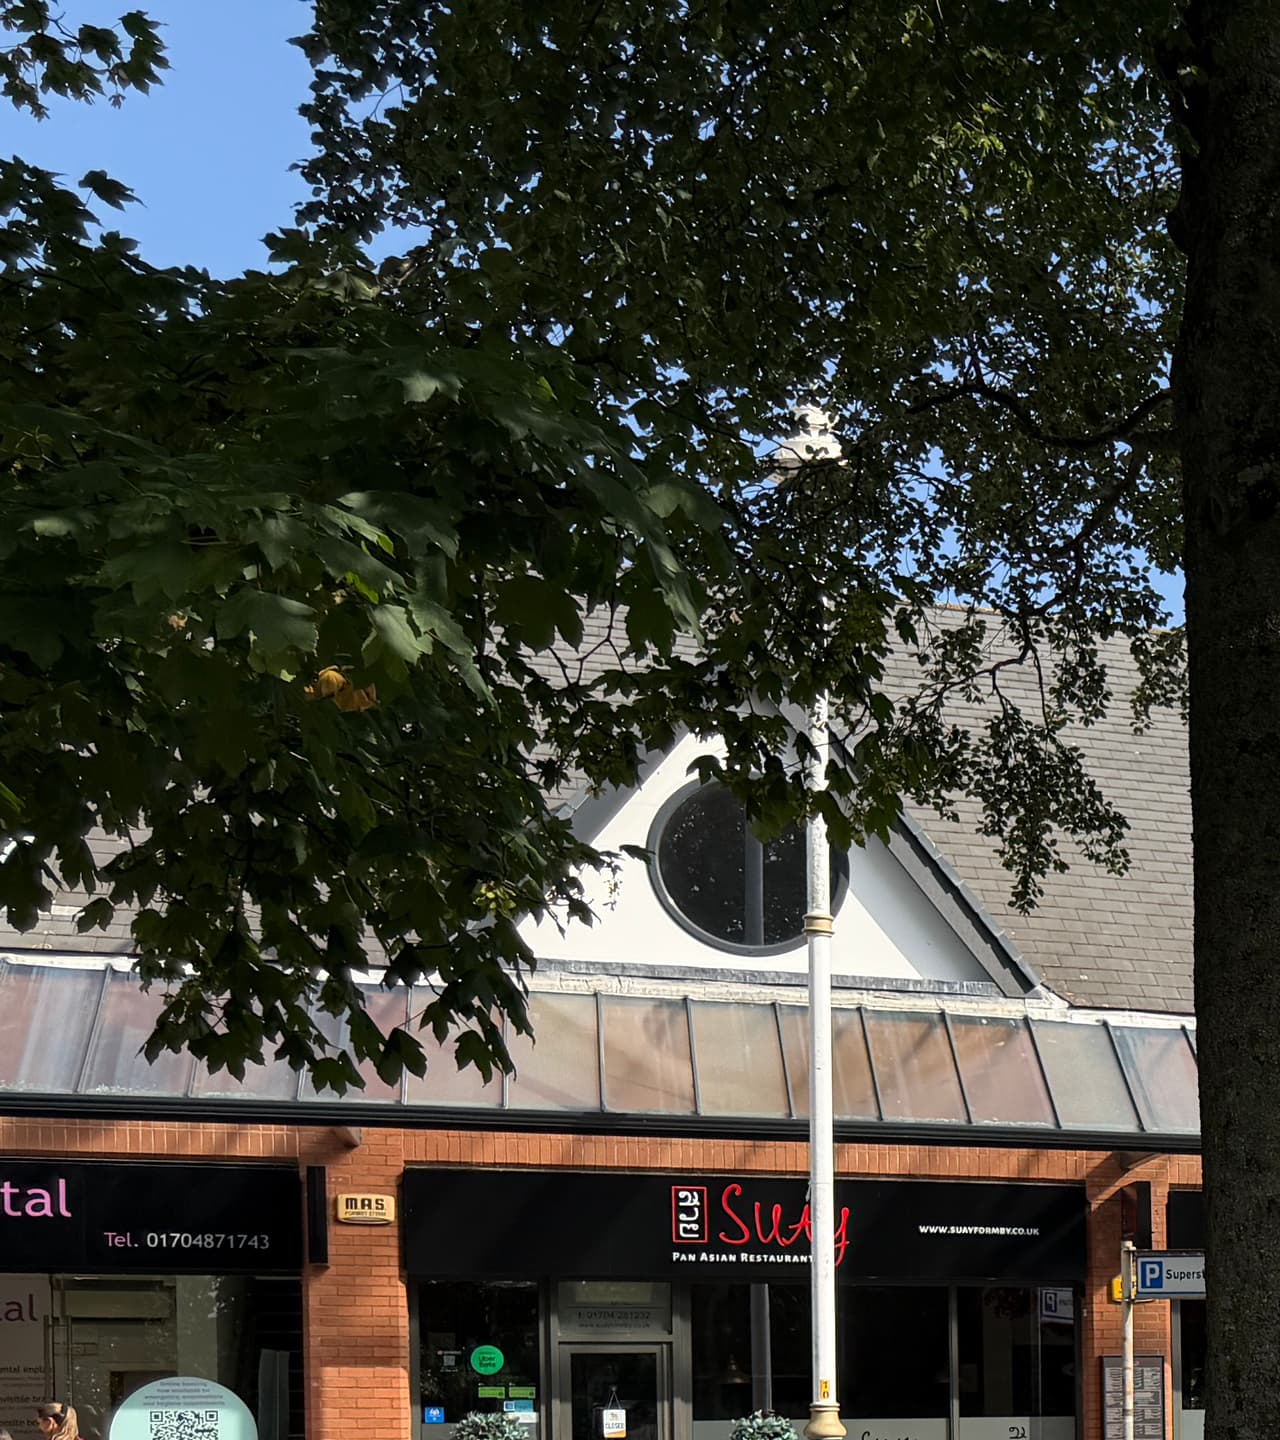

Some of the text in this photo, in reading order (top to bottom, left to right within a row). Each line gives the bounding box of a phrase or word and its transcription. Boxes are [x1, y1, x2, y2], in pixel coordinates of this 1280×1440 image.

[0, 1178, 72, 1218] tal
[104, 1232, 270, 1249] Tel. 01704871743
